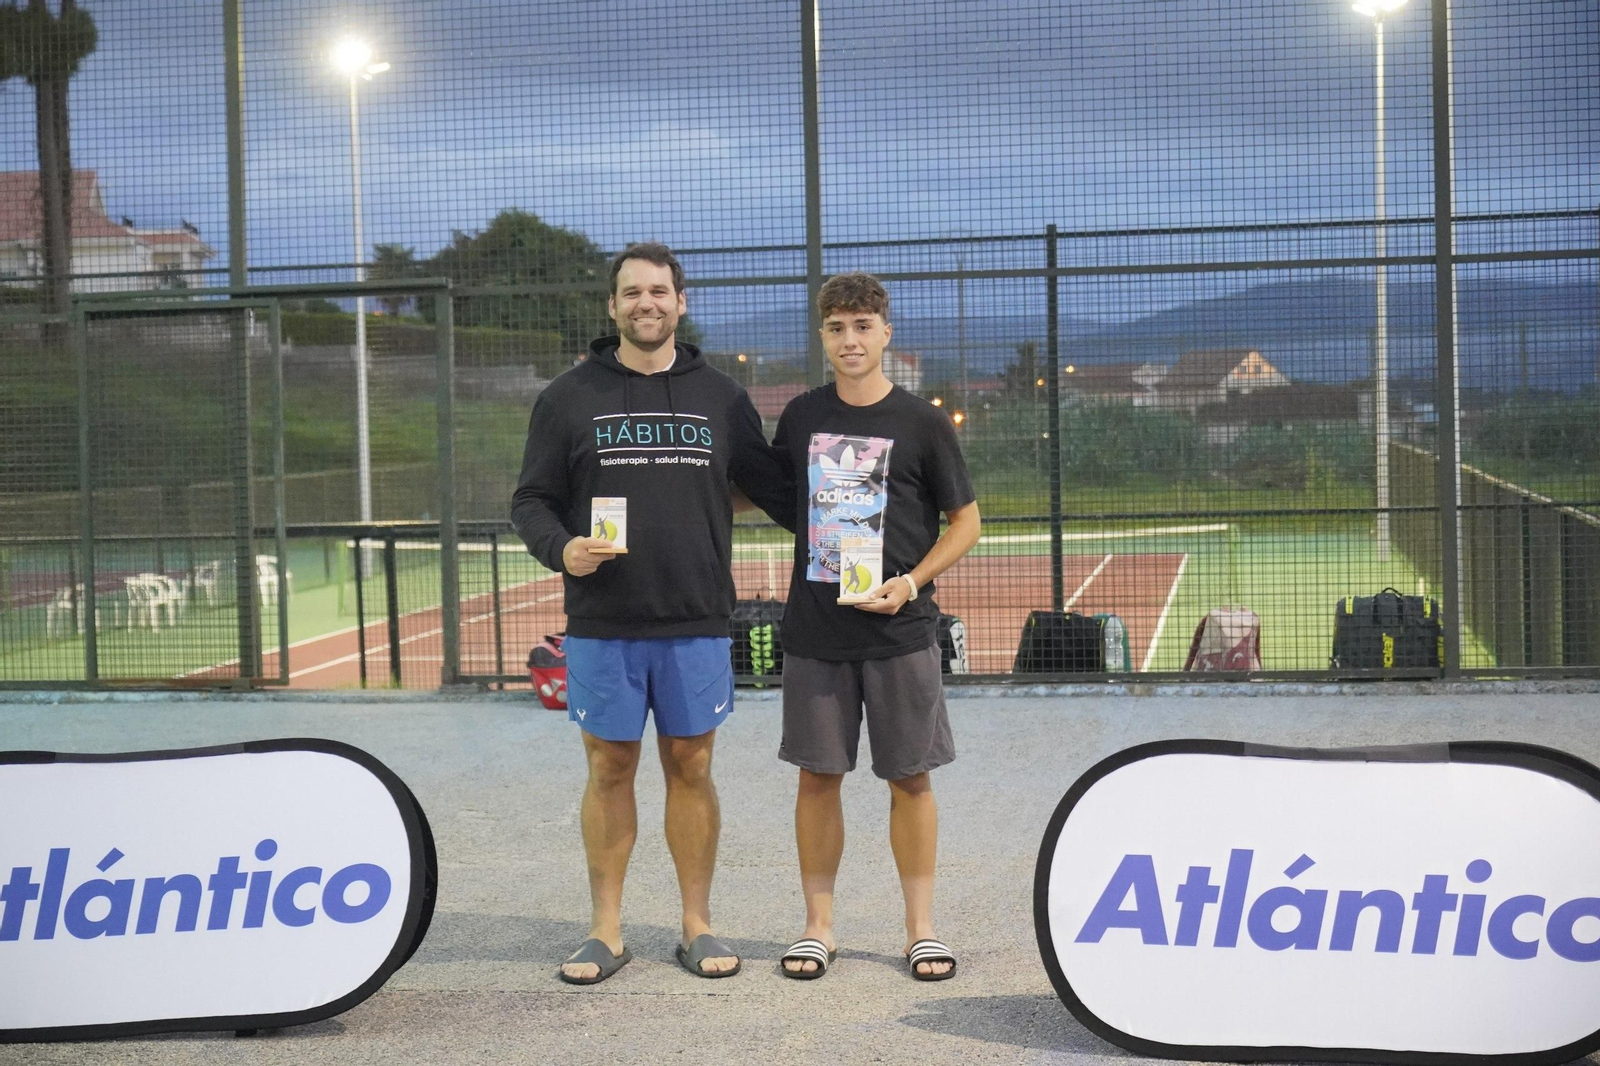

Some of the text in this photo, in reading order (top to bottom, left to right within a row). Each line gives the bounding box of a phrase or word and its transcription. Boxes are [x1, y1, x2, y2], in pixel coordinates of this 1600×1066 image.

[596, 419, 712, 446] HÁBITOS
[600, 457, 648, 466] fisioterapia
[655, 455, 678, 464] salud
[816, 487, 875, 506] adidas
[820, 507, 849, 524] MARKE
[848, 509, 864, 522] MIT
[827, 530, 863, 538] STREIFEN
[823, 559, 841, 572] THE
[0, 838, 392, 942] tlántico
[1073, 848, 1600, 963] Atlántico
